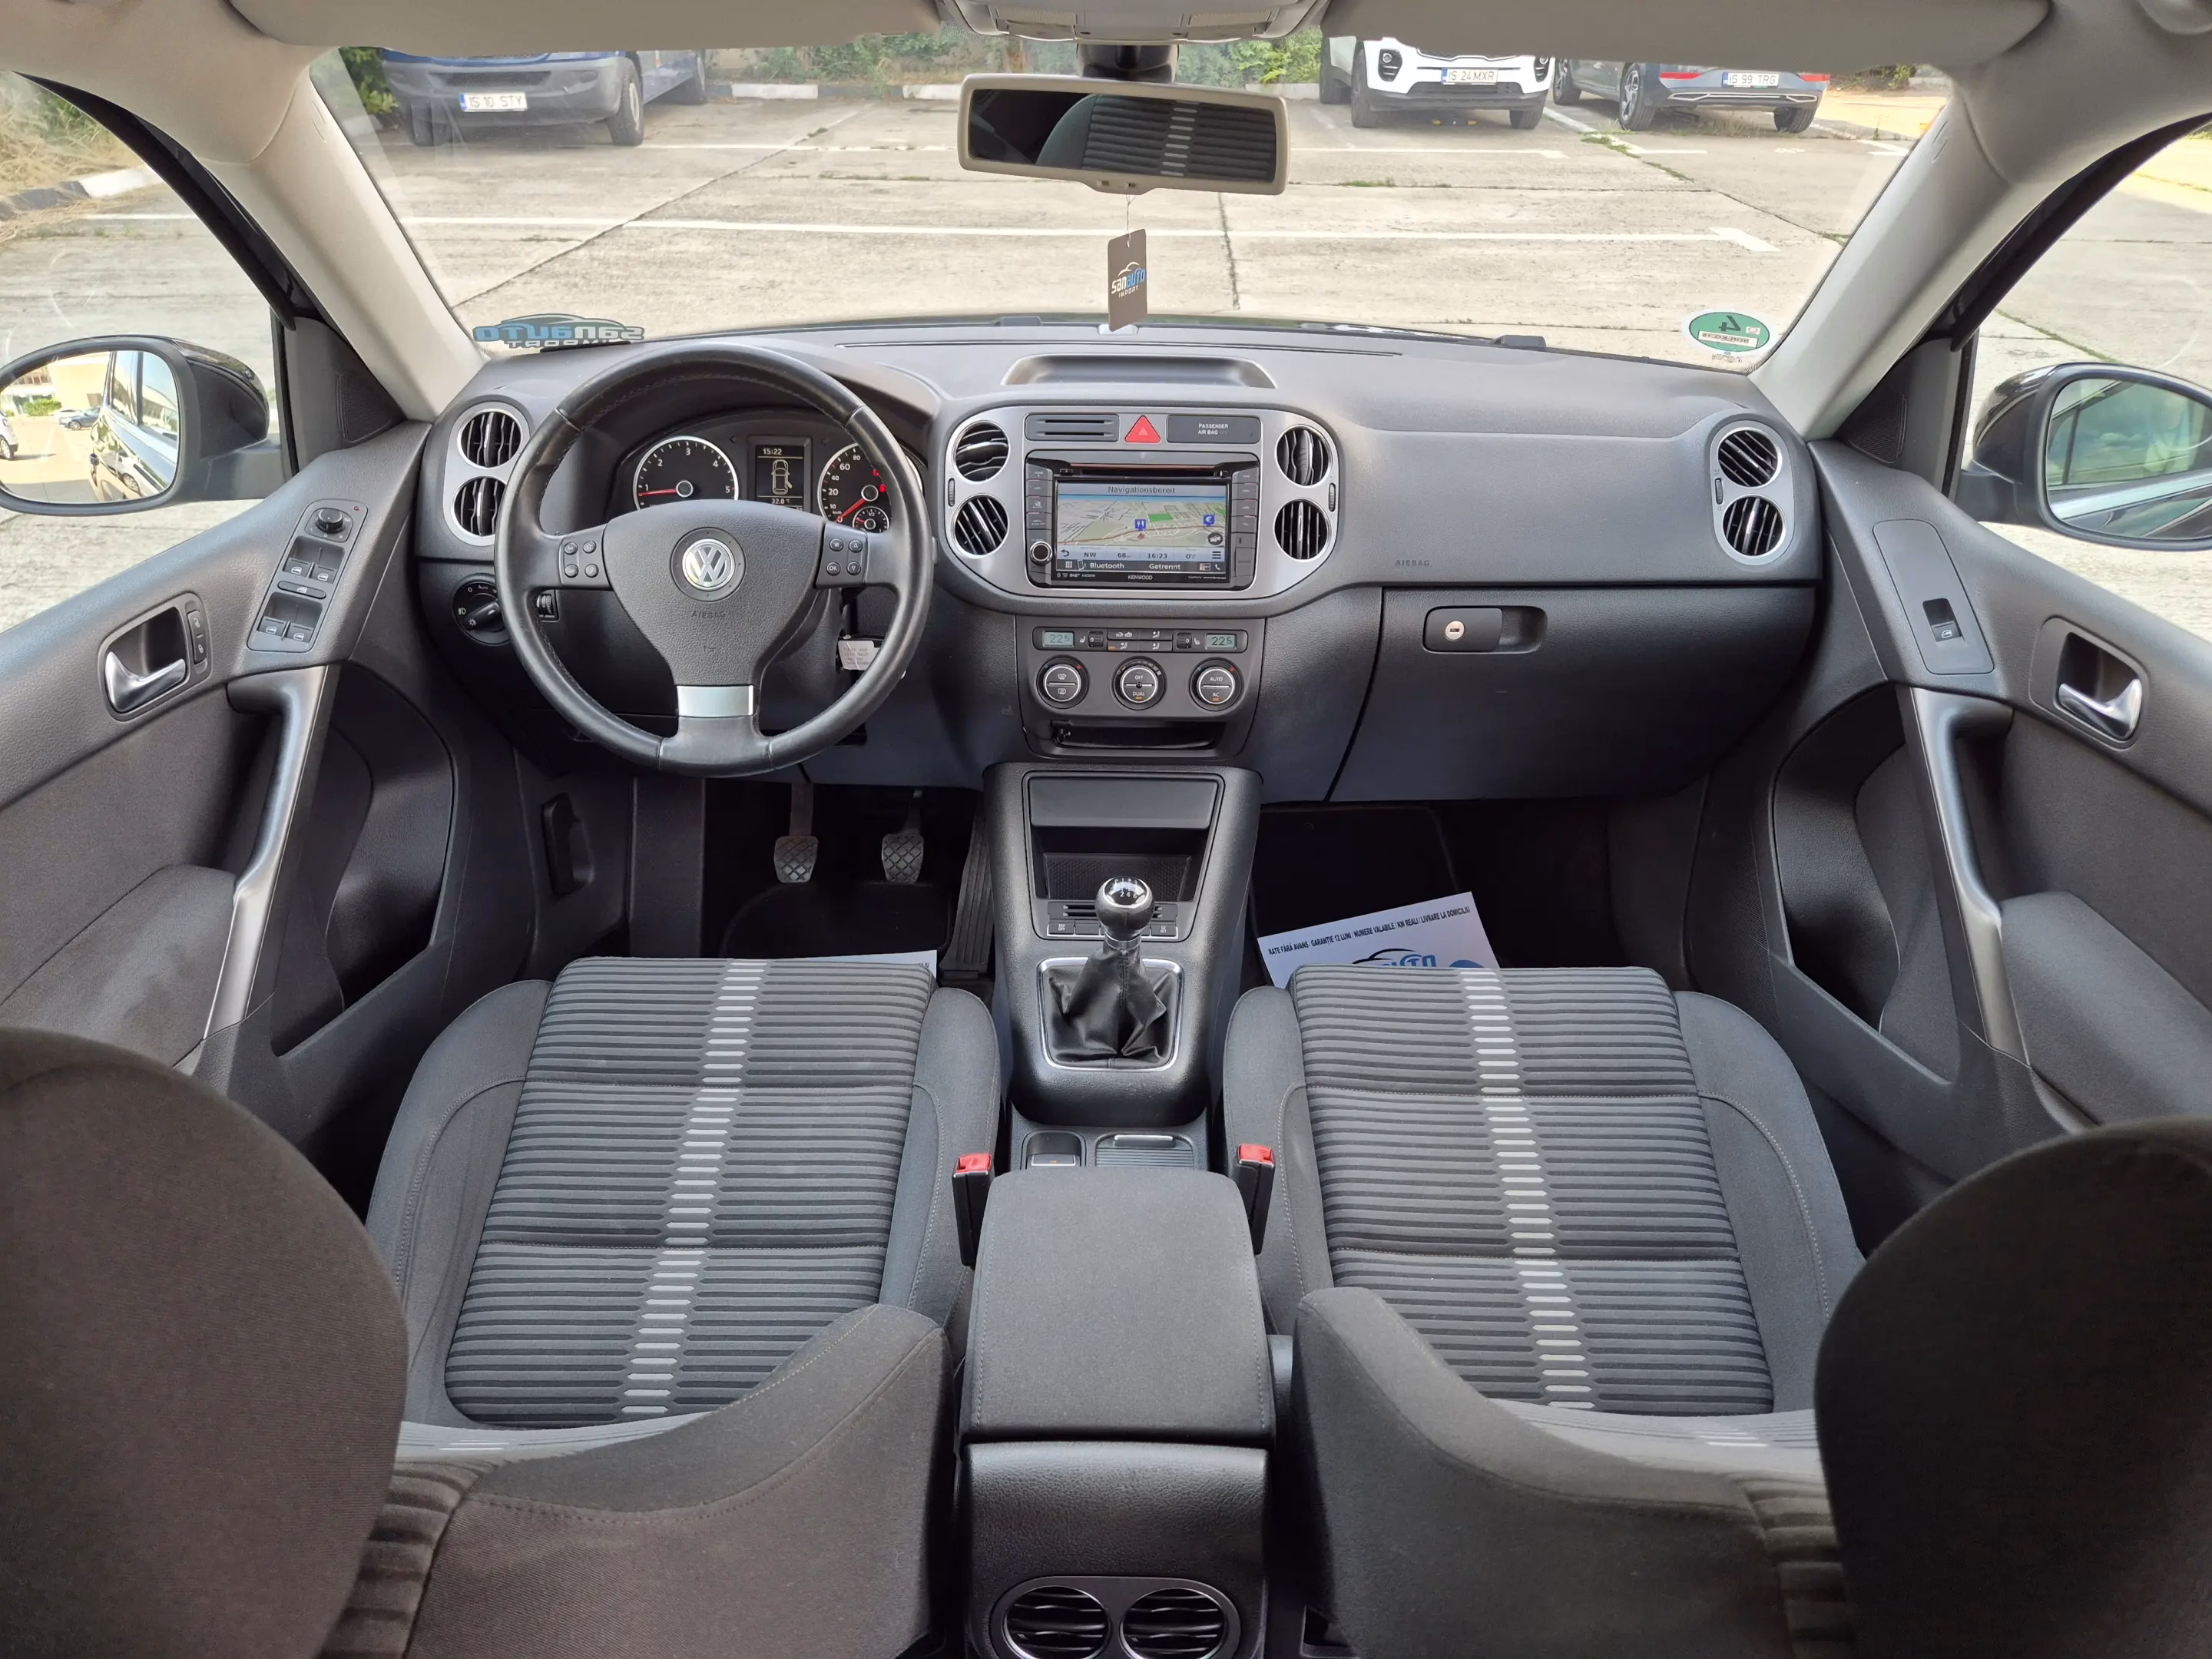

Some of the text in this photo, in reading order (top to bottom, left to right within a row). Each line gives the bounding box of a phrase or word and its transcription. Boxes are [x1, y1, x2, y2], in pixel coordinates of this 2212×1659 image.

[1448, 71, 1458, 81] IS
[1472, 71, 1495, 81] MXR
[1729, 75, 1777, 84] IS 99 TRG
[468, 95, 481, 108] IS
[499, 95, 522, 108] STY
[657, 459, 663, 467] 2
[725, 485, 730, 493] 5
[1108, 485, 1176, 495] Navigationsbereit
[1268, 947, 1281, 955] RATE
[1294, 941, 1309, 950] AVANS
[1335, 934, 1341, 942] 12
[1341, 932, 1352, 940] LUNI
[1354, 927, 1373, 937] NUMERE
[1373, 922, 1395, 933] VALABILE
[1405, 918, 1419, 927] REALI
[1421, 912, 1440, 923] LIVRARE
[1440, 911, 1447, 919] LA
[1447, 906, 1470, 917] DOMICILIU
